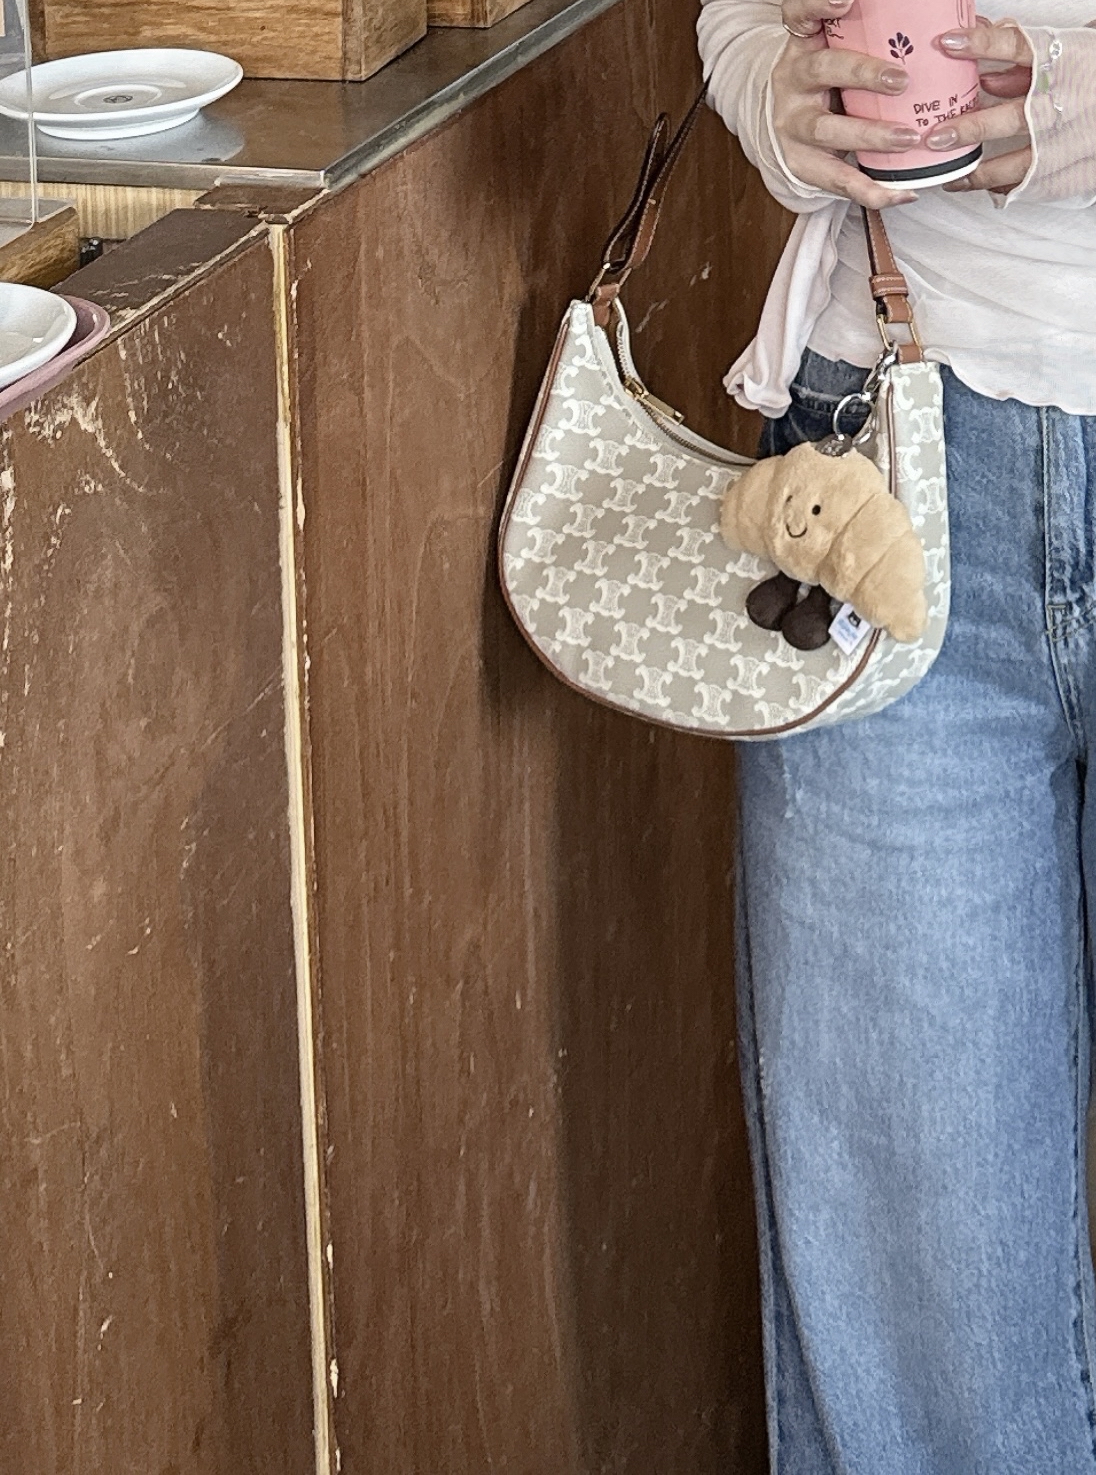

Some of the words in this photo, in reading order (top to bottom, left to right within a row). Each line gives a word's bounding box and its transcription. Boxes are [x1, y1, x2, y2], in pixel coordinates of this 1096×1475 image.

[913, 100, 940, 114] DIVE
[949, 94, 957, 106] IN
[916, 118, 929, 127] TO
